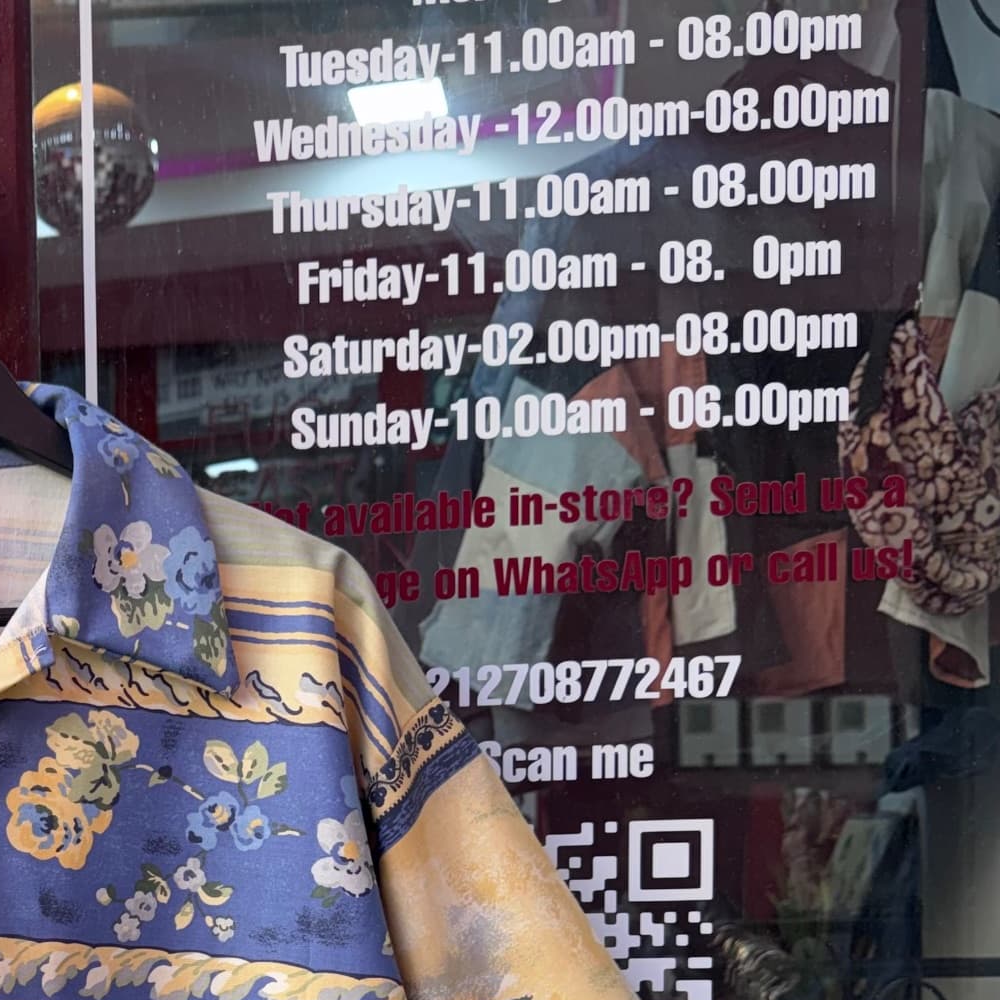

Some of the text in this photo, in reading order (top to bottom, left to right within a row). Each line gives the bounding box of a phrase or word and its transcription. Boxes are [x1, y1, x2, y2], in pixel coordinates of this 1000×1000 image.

[279, 26, 635, 88] Tuesday-11.00am
[678, 9, 862, 61] 08.00pm
[253, 112, 480, 162] Wednesday
[266, 173, 650, 235] Thursday-11.00am
[692, 158, 876, 209] 08.00pm
[298, 247, 617, 305] Friday-11.00am
[291, 392, 626, 450] Sunday-10.00am
[668, 382, 850, 431] 06.00pm
[324, 488, 495, 537] available
[509, 477, 694, 527] in-store?
[710, 472, 808, 517] Send
[820, 475, 870, 512] us
[882, 473, 908, 509] a
[433, 566, 480, 601] on
[493, 553, 693, 605] WhatsApp
[706, 552, 754, 587] or
[767, 541, 839, 586] call
[851, 537, 914, 582] us!
[591, 741, 654, 780] me
